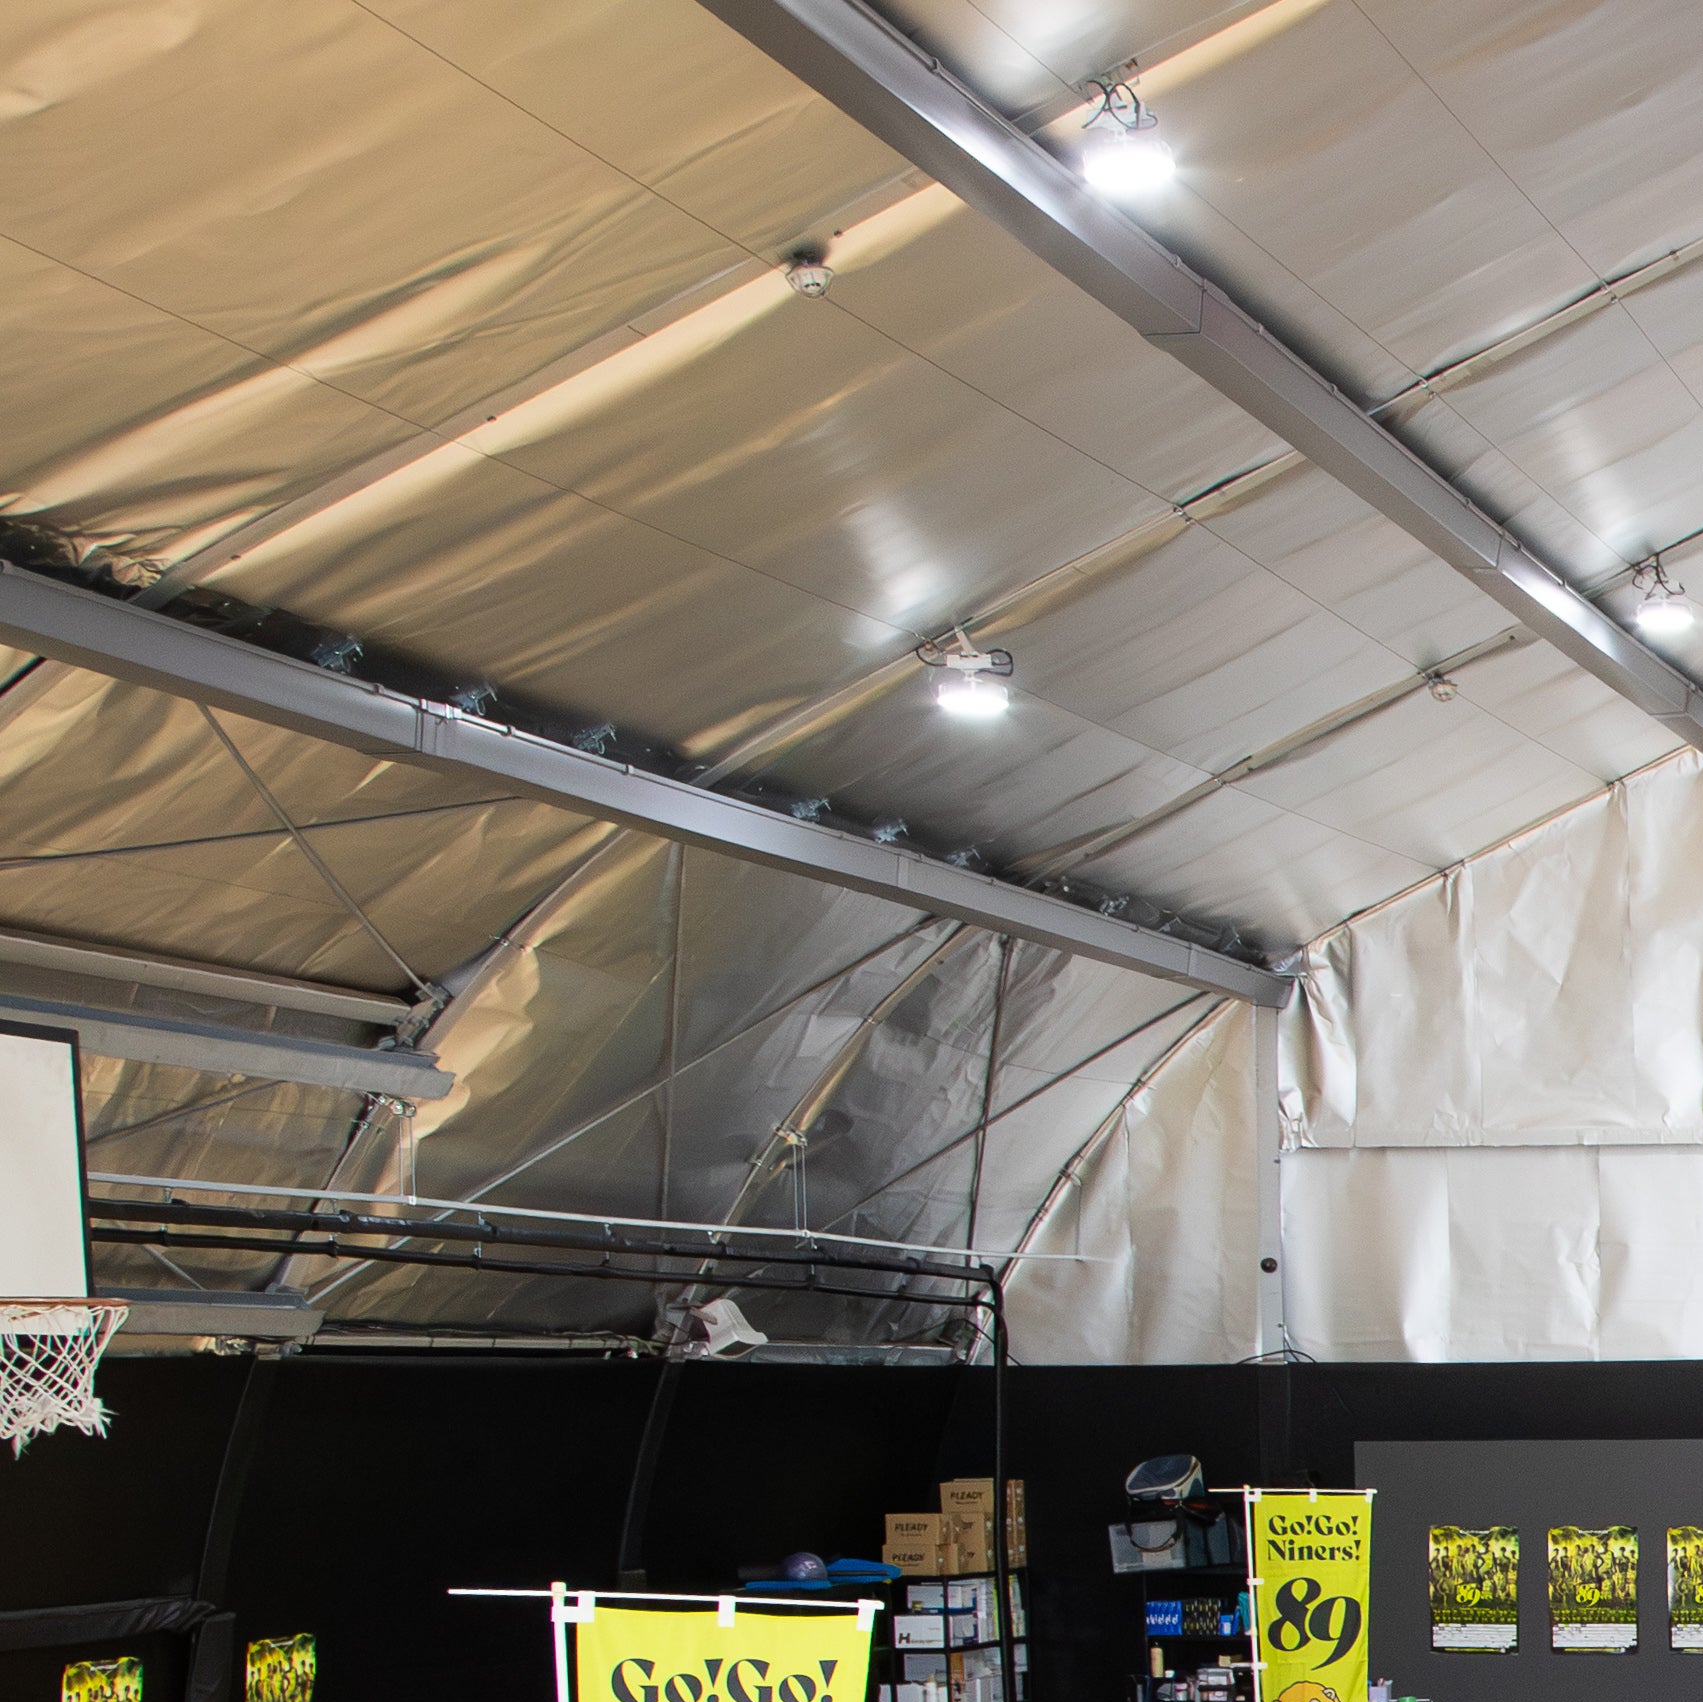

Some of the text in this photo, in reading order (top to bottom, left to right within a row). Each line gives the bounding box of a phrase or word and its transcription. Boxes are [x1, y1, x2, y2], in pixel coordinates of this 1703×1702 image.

[1268, 1515, 1359, 1536] Go!Go!
[1267, 1539, 1361, 1562] Niners!
[1267, 1577, 1362, 1671] 89
